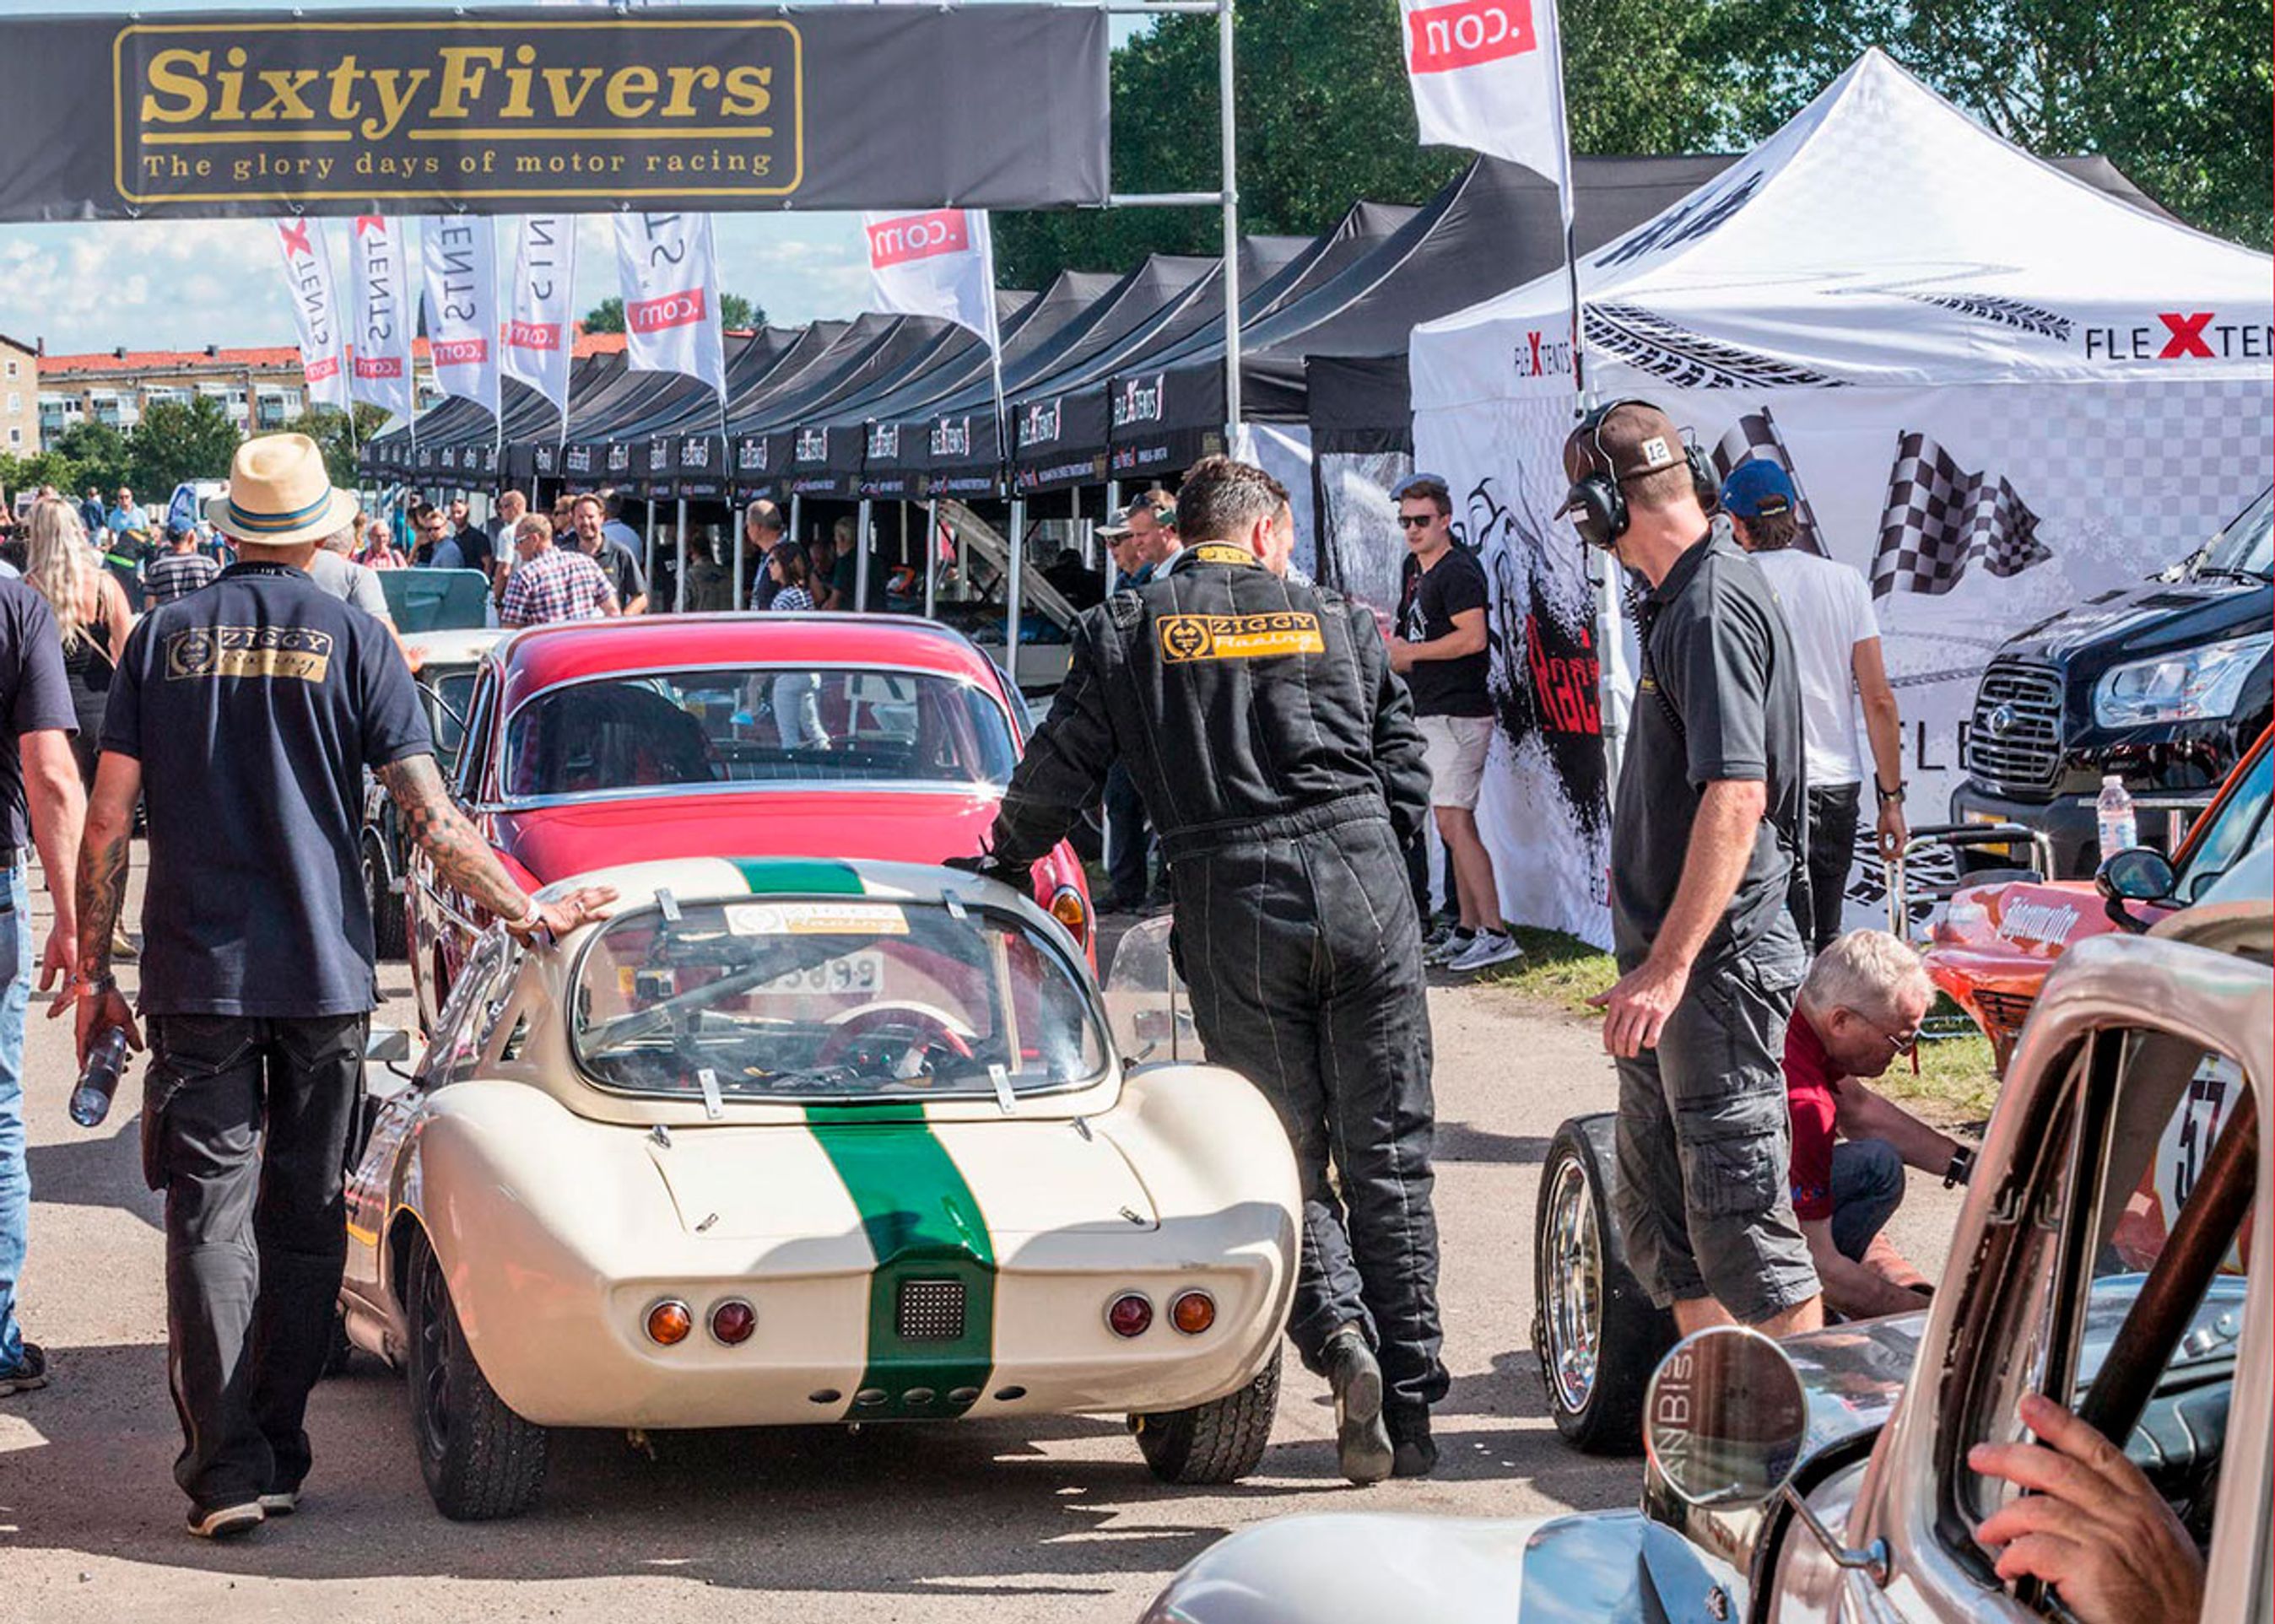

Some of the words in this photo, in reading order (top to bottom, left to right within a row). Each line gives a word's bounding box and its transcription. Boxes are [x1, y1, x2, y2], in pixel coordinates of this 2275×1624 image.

[141, 46, 771, 140] SixtyFivers
[143, 155, 212, 177] The
[233, 153, 334, 181] glory
[355, 152, 440, 178] days
[460, 150, 496, 174] of
[516, 153, 625, 173] motor
[646, 149, 771, 175] racing
[1649, 441, 1667, 461] 12
[1213, 616, 1310, 634] ZIGGY
[222, 632, 327, 651] ZIGGY
[1215, 633, 1314, 651] Racing
